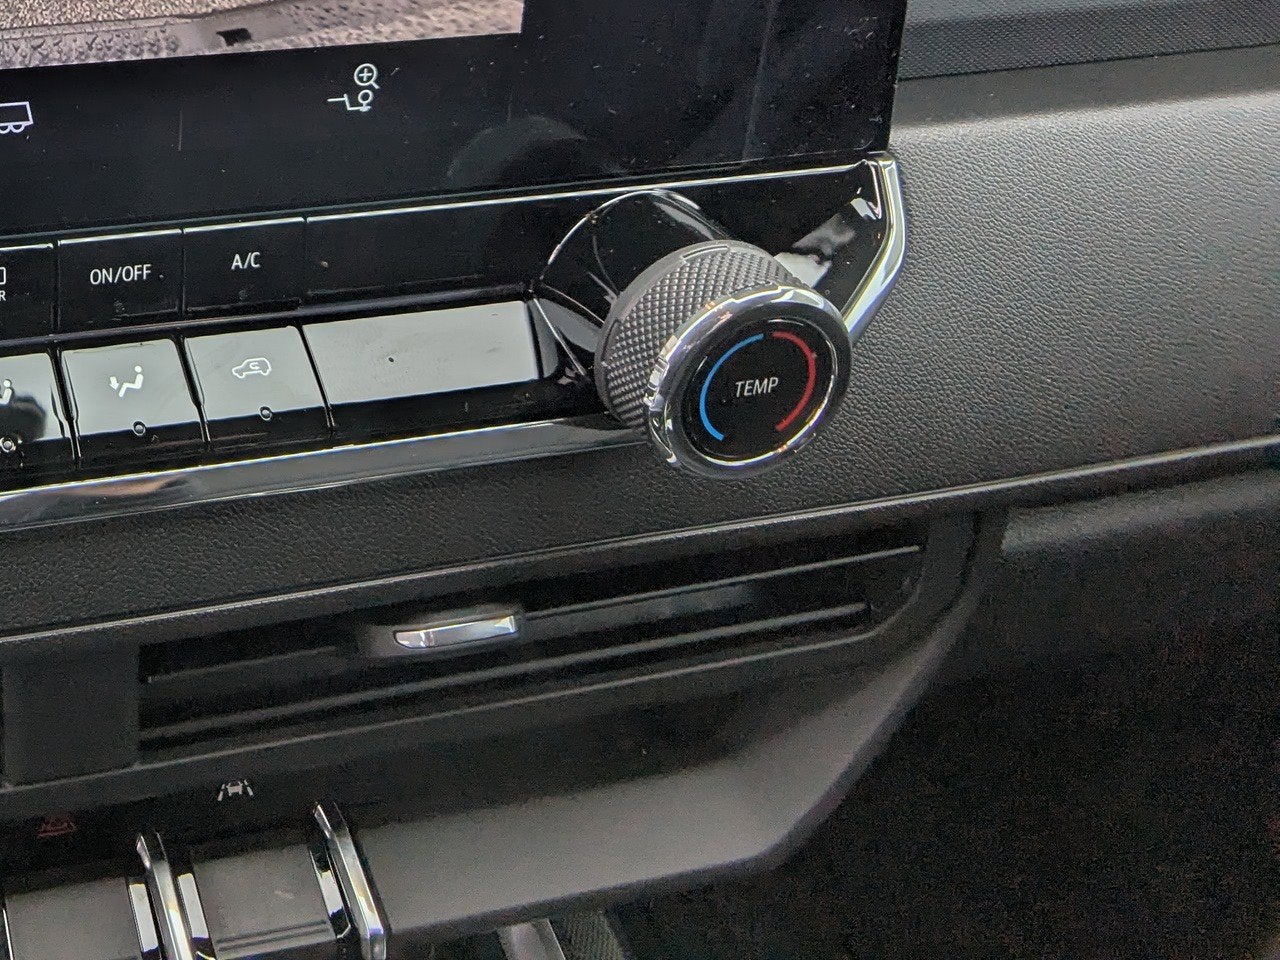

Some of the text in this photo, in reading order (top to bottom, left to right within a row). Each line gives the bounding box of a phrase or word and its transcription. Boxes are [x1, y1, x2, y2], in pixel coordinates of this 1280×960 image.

[231, 252, 261, 270] A/C
[89, 263, 152, 285] ON/OFF
[735, 377, 779, 398] TEMP
